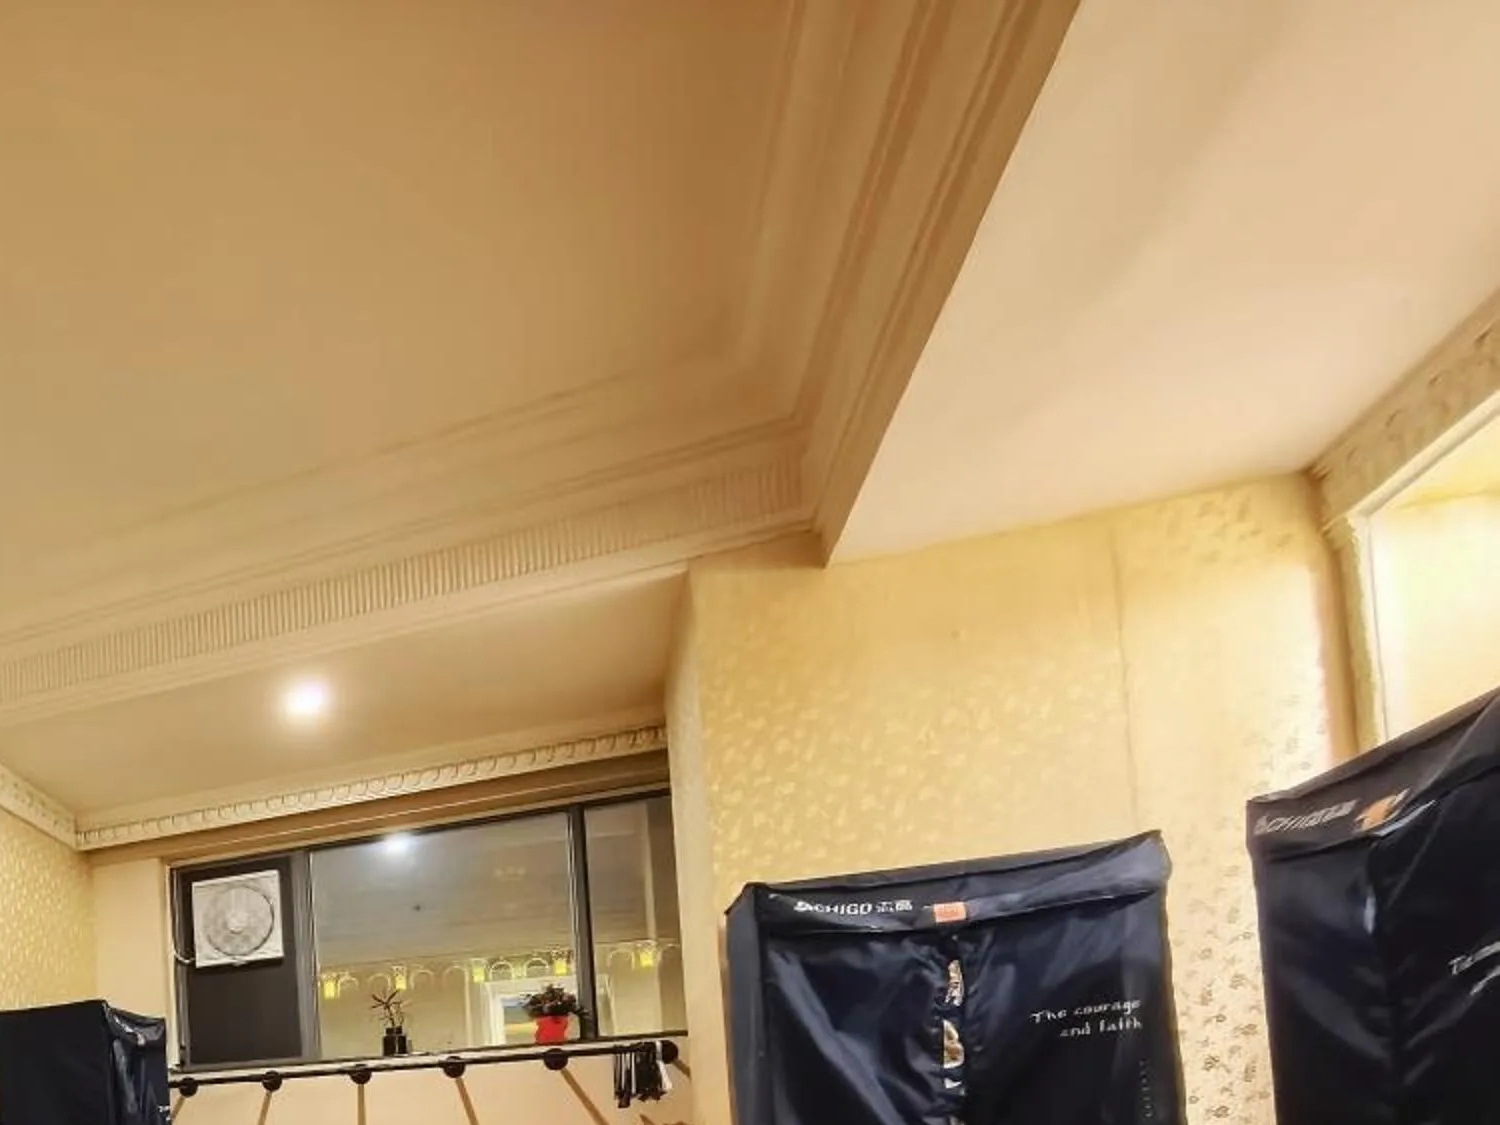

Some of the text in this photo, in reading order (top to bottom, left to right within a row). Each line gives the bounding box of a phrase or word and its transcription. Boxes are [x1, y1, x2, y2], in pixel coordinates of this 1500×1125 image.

[1029, 1000, 1141, 1023] The courage
[1060, 1016, 1143, 1037] and faith
